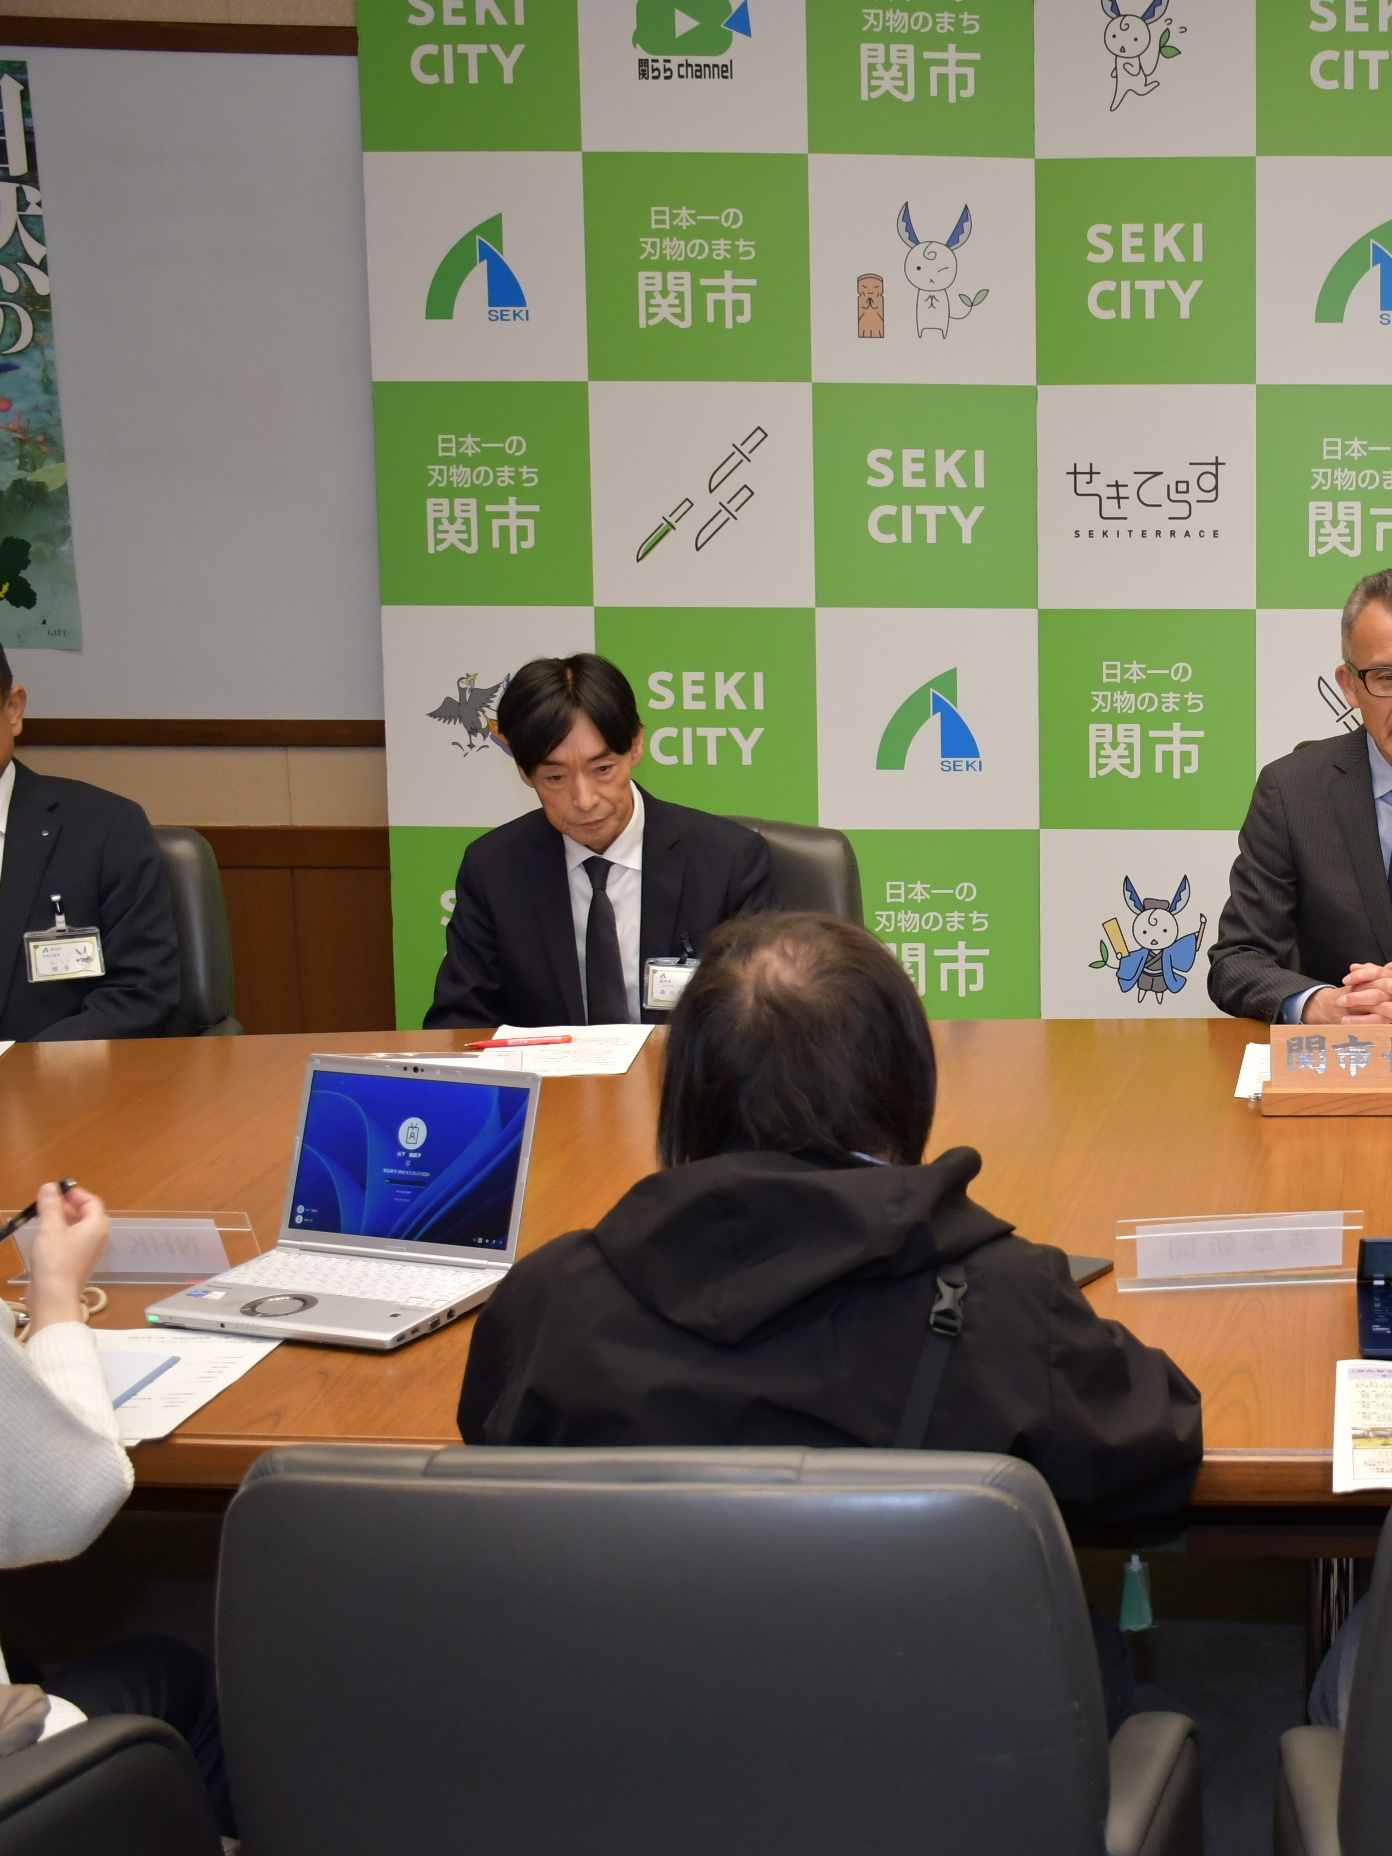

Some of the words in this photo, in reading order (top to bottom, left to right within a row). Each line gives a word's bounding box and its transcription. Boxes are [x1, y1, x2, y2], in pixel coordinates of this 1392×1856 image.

[408, 0, 524, 25] SEKI
[862, 9, 979, 34] 刃物のまち
[411, 44, 525, 84] CITY
[638, 59, 673, 80] 関らら
[678, 59, 732, 79] channel
[860, 43, 980, 103] 関市
[651, 206, 743, 229] 日本一の
[640, 237, 755, 261] 刃物のまち
[1087, 223, 1203, 263] SEKI
[638, 270, 757, 329] 関市
[1088, 280, 1203, 319] CITY
[488, 310, 529, 321] SEKI
[438, 434, 526, 457] 日本一の
[428, 465, 538, 487] 刃物のまち
[867, 449, 984, 488] SEKI
[1066, 456, 1225, 520] せきてらす
[427, 497, 540, 554] 関市
[868, 505, 984, 544] CITY
[1074, 530, 1218, 538] SEKITERRACE
[1103, 661, 1192, 683] 日本一の
[648, 671, 764, 710] SEKI
[1091, 691, 1203, 713] 刃物のまち
[650, 727, 764, 765] CITY
[1089, 722, 1204, 779] 関市
[941, 760, 982, 772] SEKI
[886, 881, 977, 903] 日本一の
[875, 910, 988, 932] 刃物のまち
